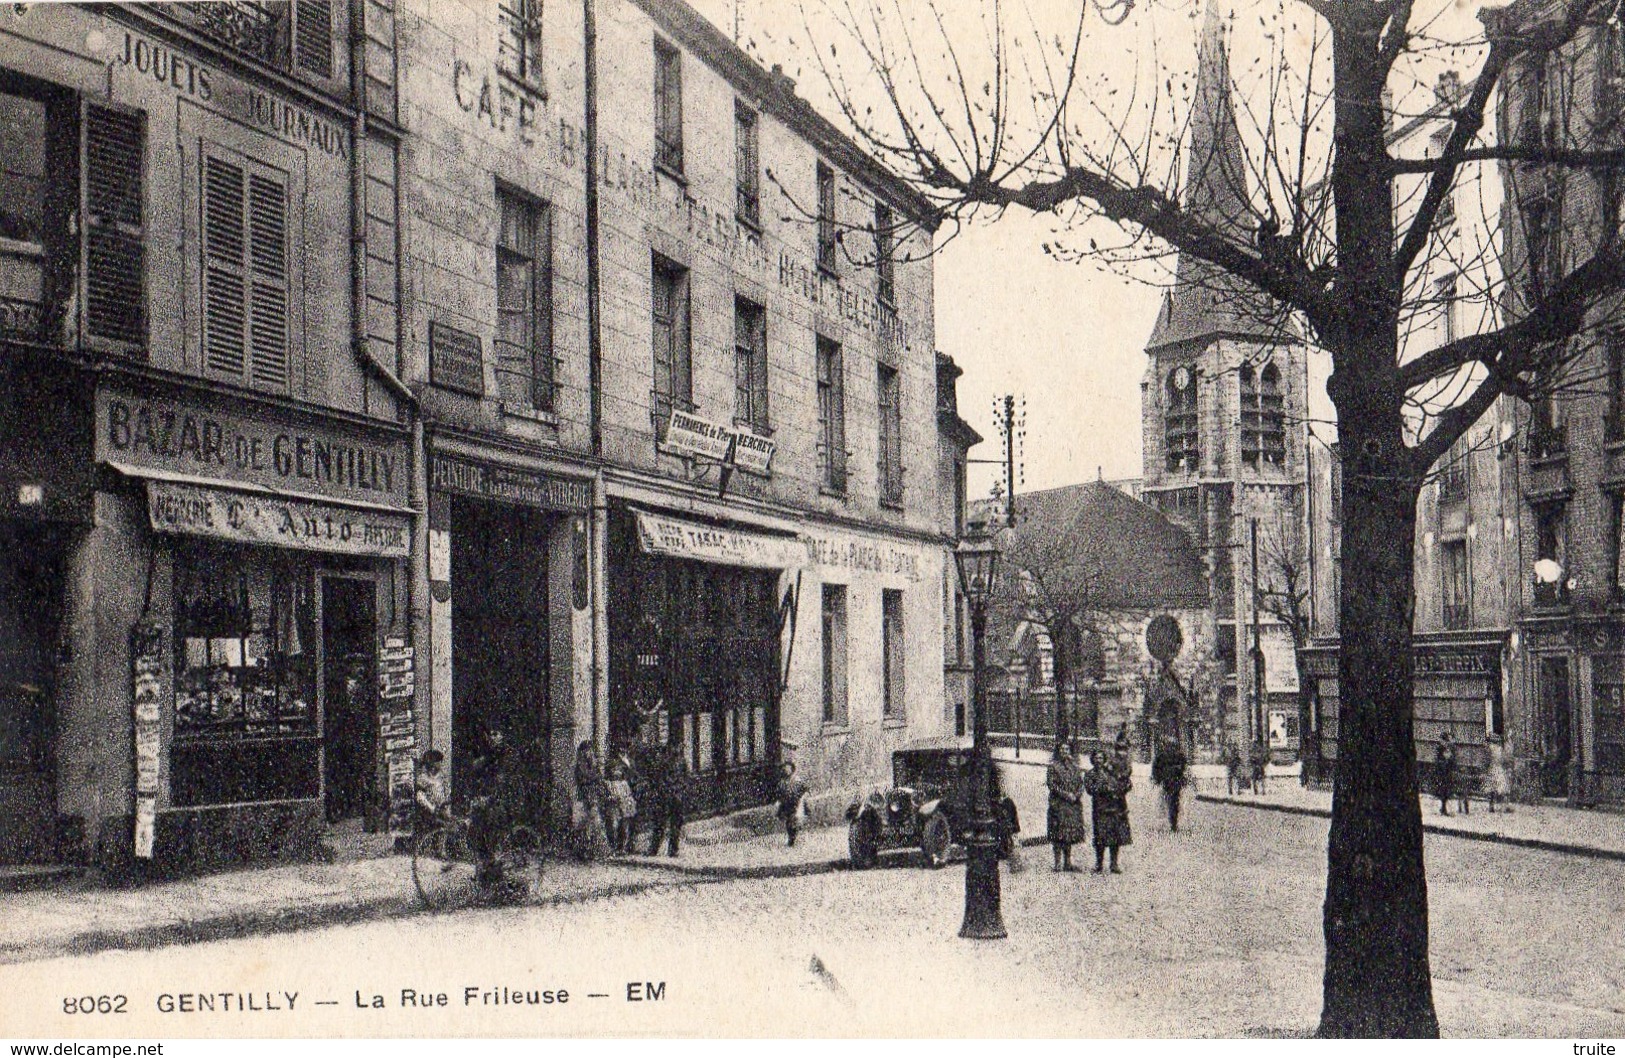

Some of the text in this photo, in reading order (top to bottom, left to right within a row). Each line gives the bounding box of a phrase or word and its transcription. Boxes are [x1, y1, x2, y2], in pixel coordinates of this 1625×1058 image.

[118, 32, 348, 160] JOUETS JOURNAUX
[454, 58, 536, 148] CAFE
[108, 397, 396, 491] BAZAR DE GENTILLY
[431, 457, 484, 493] PEINTURE
[737, 433, 774, 454] BERCHET
